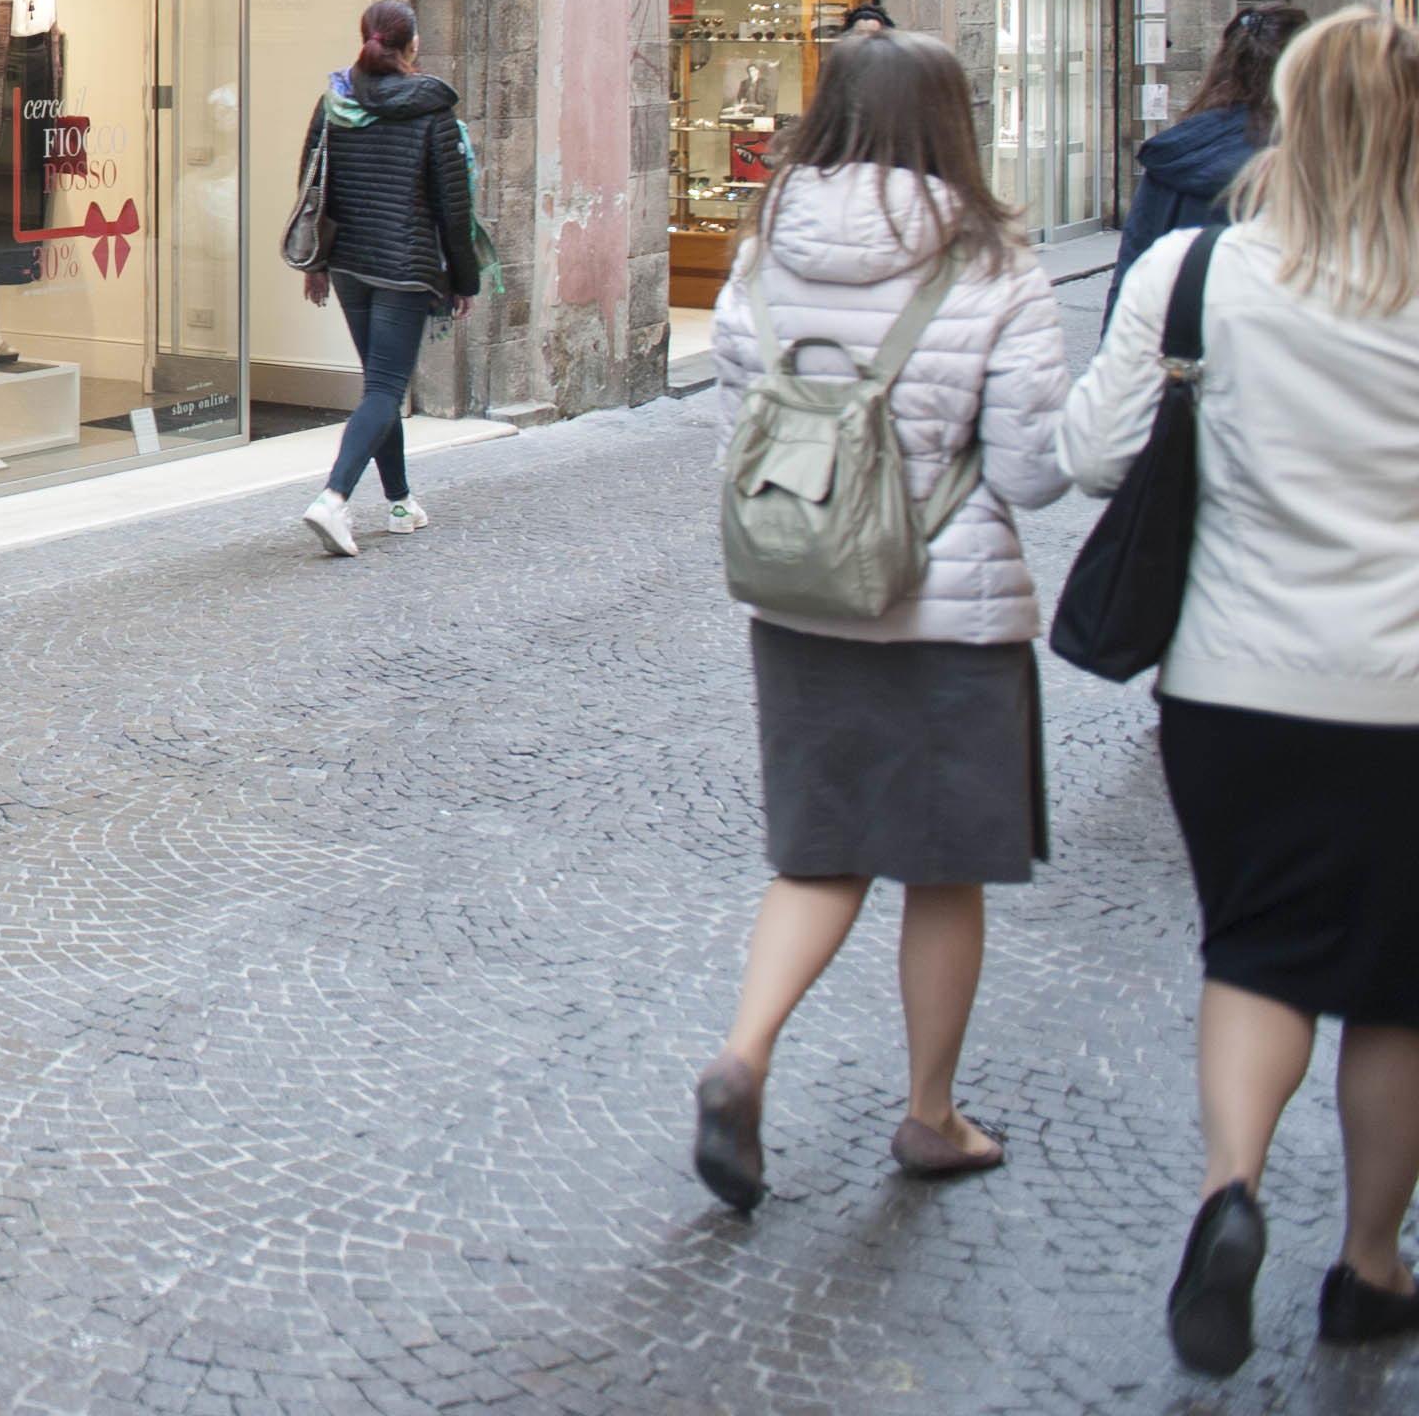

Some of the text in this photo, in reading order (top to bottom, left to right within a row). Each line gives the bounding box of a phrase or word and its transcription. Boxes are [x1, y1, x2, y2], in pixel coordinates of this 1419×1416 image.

[42, 120, 129, 159] FIOCCO
[42, 158, 118, 195] ROSSO
[170, 392, 230, 417] shop online
